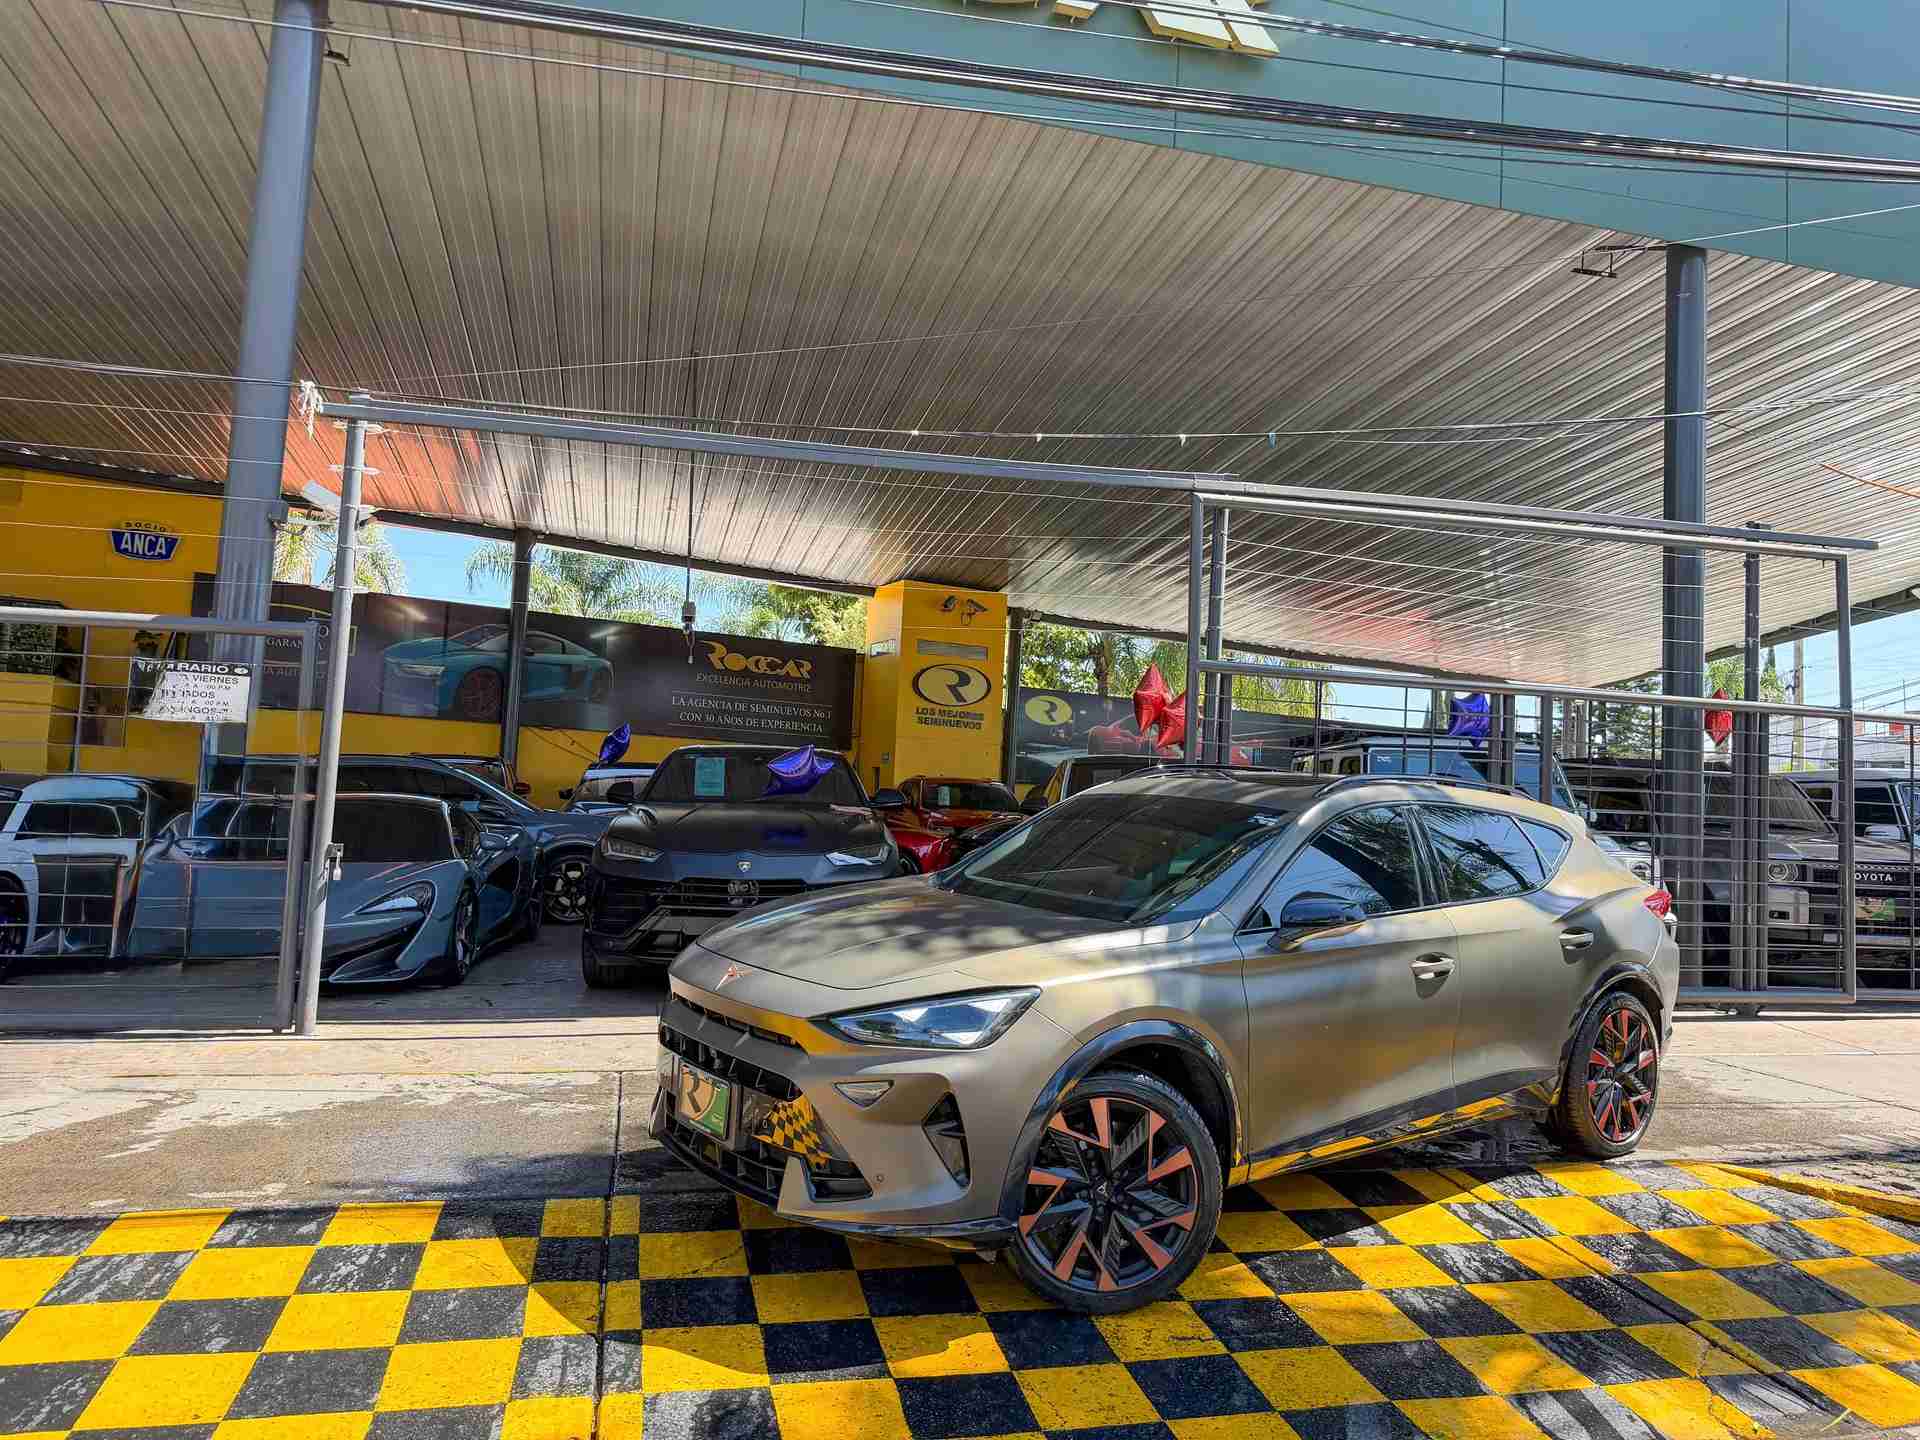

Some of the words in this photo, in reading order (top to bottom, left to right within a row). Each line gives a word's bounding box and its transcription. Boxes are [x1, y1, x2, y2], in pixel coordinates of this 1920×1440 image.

[120, 532, 167, 556] ANCA
[699, 640, 812, 679] ROCCAR
[192, 674, 239, 685] VIERNES
[696, 672, 751, 689] EXCELENCIA
[753, 679, 812, 694] AUTOMOTRIZ
[672, 696, 685, 706] LA
[686, 697, 732, 712] AGENCIA
[734, 702, 748, 712] DE
[750, 703, 812, 718] SEMINUEVOS
[915, 706, 937, 717] LOS
[680, 712, 701, 722] CON
[717, 713, 744, 727] AÑOS
[746, 718, 759, 728] DE
[761, 719, 824, 734] EXPERIENCIA
[917, 716, 982, 730] SEMINUEVOS
[1855, 872, 1893, 881] OYOTA
